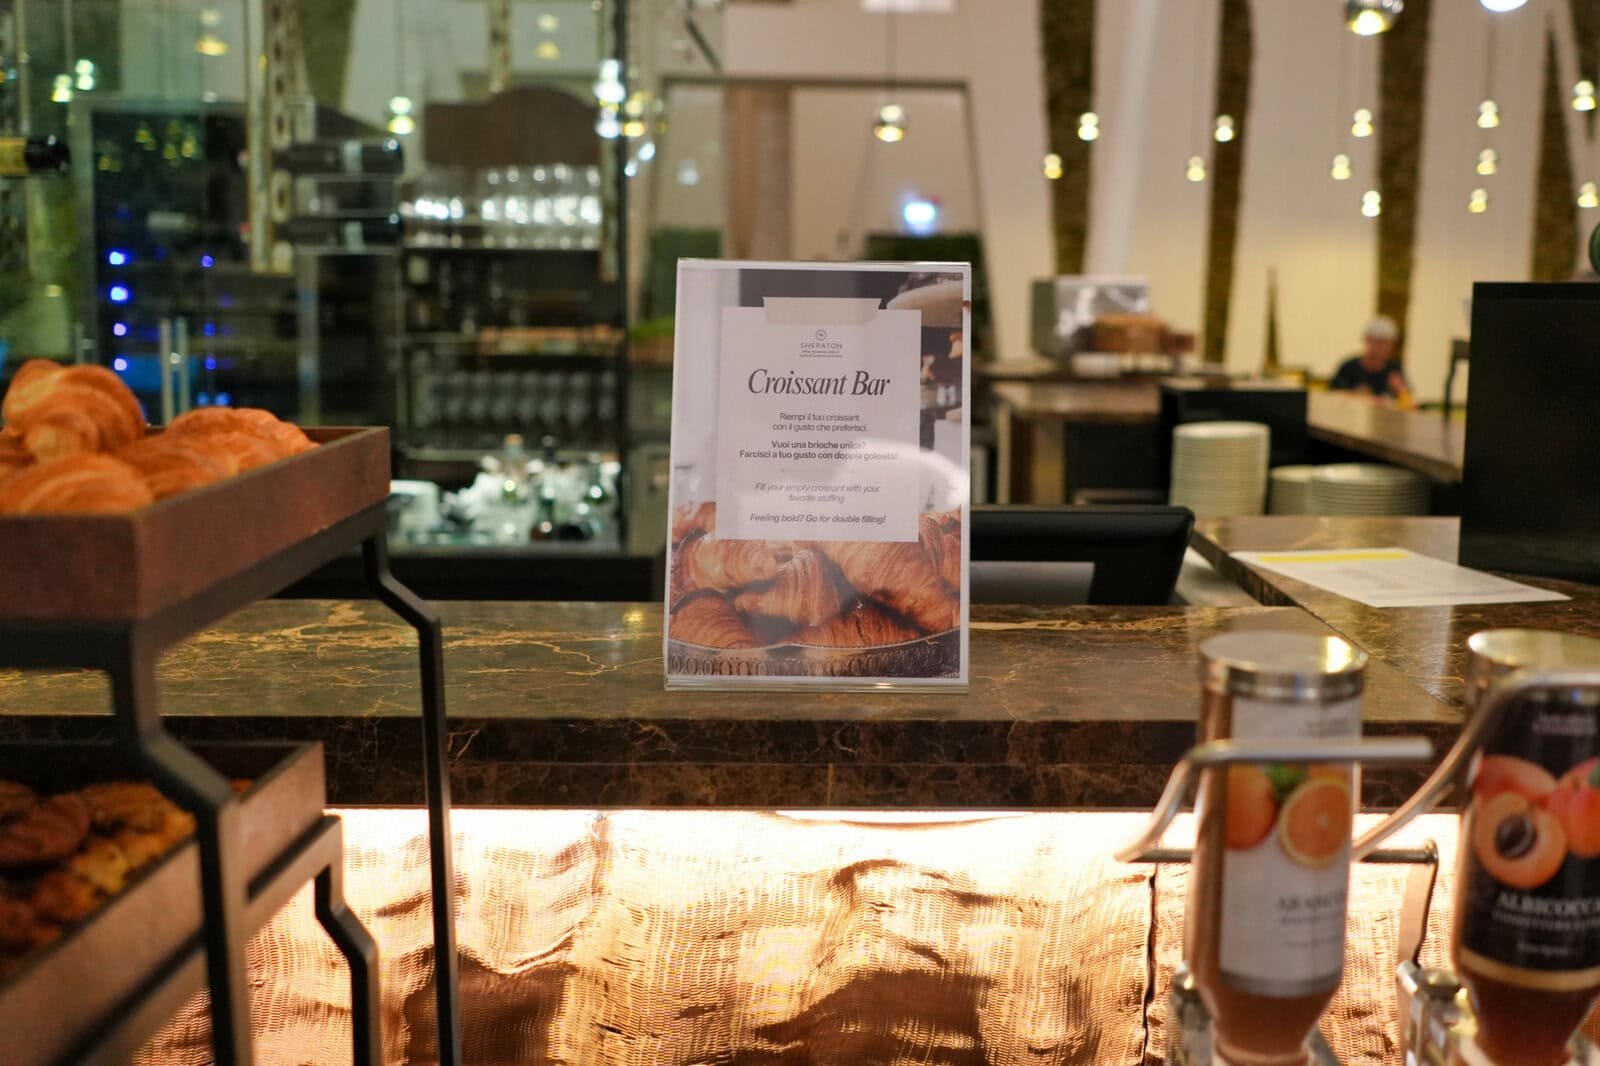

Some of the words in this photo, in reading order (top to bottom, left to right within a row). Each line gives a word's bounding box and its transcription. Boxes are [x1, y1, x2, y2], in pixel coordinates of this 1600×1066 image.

[748, 368, 847, 395] Croissant
[851, 370, 890, 396] Bar
[780, 413, 806, 422] Riempi
[807, 413, 811, 421] il
[788, 423, 792, 431] il
[794, 424, 815, 433] gusto
[816, 423, 831, 431] che
[832, 423, 867, 433] preferisci.
[772, 440, 789, 448] Vuoi
[808, 441, 838, 449] brioche
[740, 450, 771, 458] Farcisci
[793, 452, 816, 460] gusto
[835, 452, 862, 461] doppia
[755, 483, 766, 491] Fill
[767, 485, 783, 493] your
[786, 485, 811, 493] empty
[811, 484, 845, 492] croissant
[847, 484, 862, 492] with
[750, 514, 780, 523] Feeling
[819, 515, 831, 523] for
[832, 515, 860, 523] double
[861, 515, 886, 524] filling!
